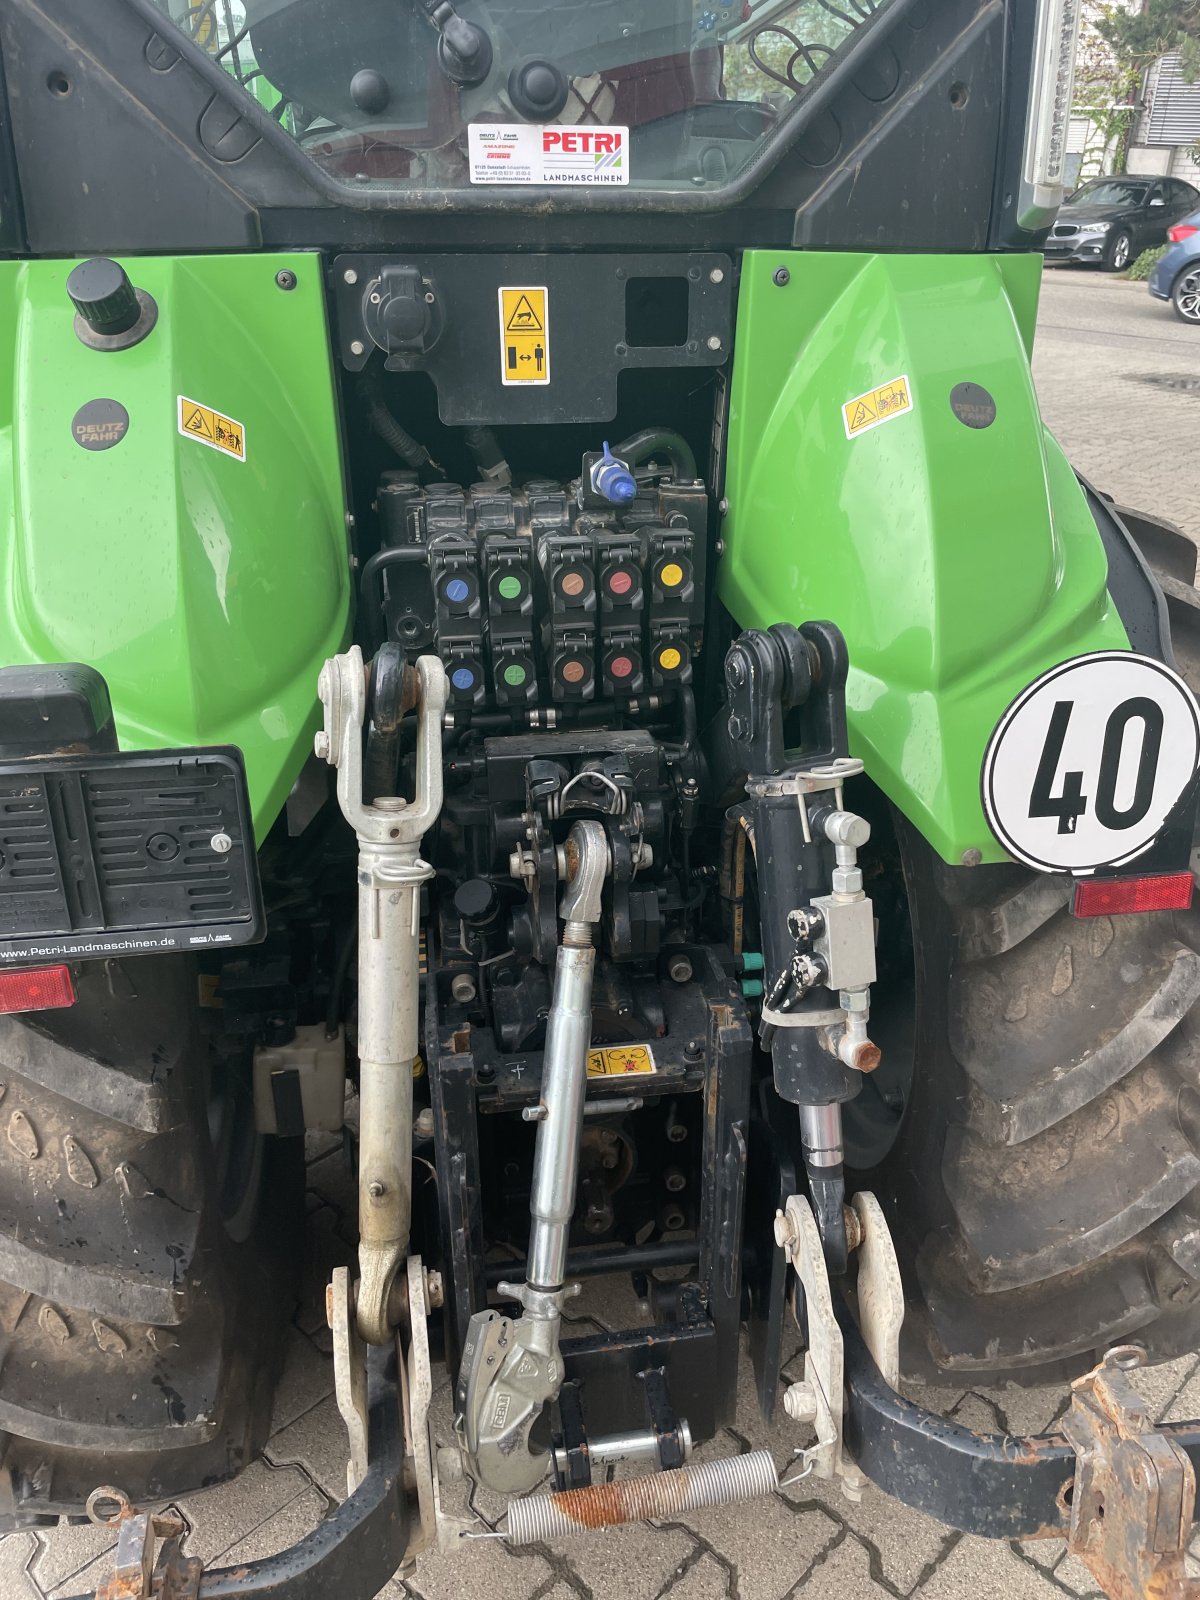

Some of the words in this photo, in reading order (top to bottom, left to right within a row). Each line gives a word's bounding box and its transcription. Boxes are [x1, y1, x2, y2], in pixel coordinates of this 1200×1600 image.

[542, 132, 622, 153] PETRI
[543, 174, 623, 182] LANDMASCHINEN
[954, 402, 993, 414] DEUTZ
[960, 411, 991, 421] FAHR
[75, 422, 125, 434] DEUTZ
[81, 431, 119, 442] FAHR
[1028, 696, 1164, 835] 40
[0, 937, 175, 958] www.Petri-Landmaschinen.de
